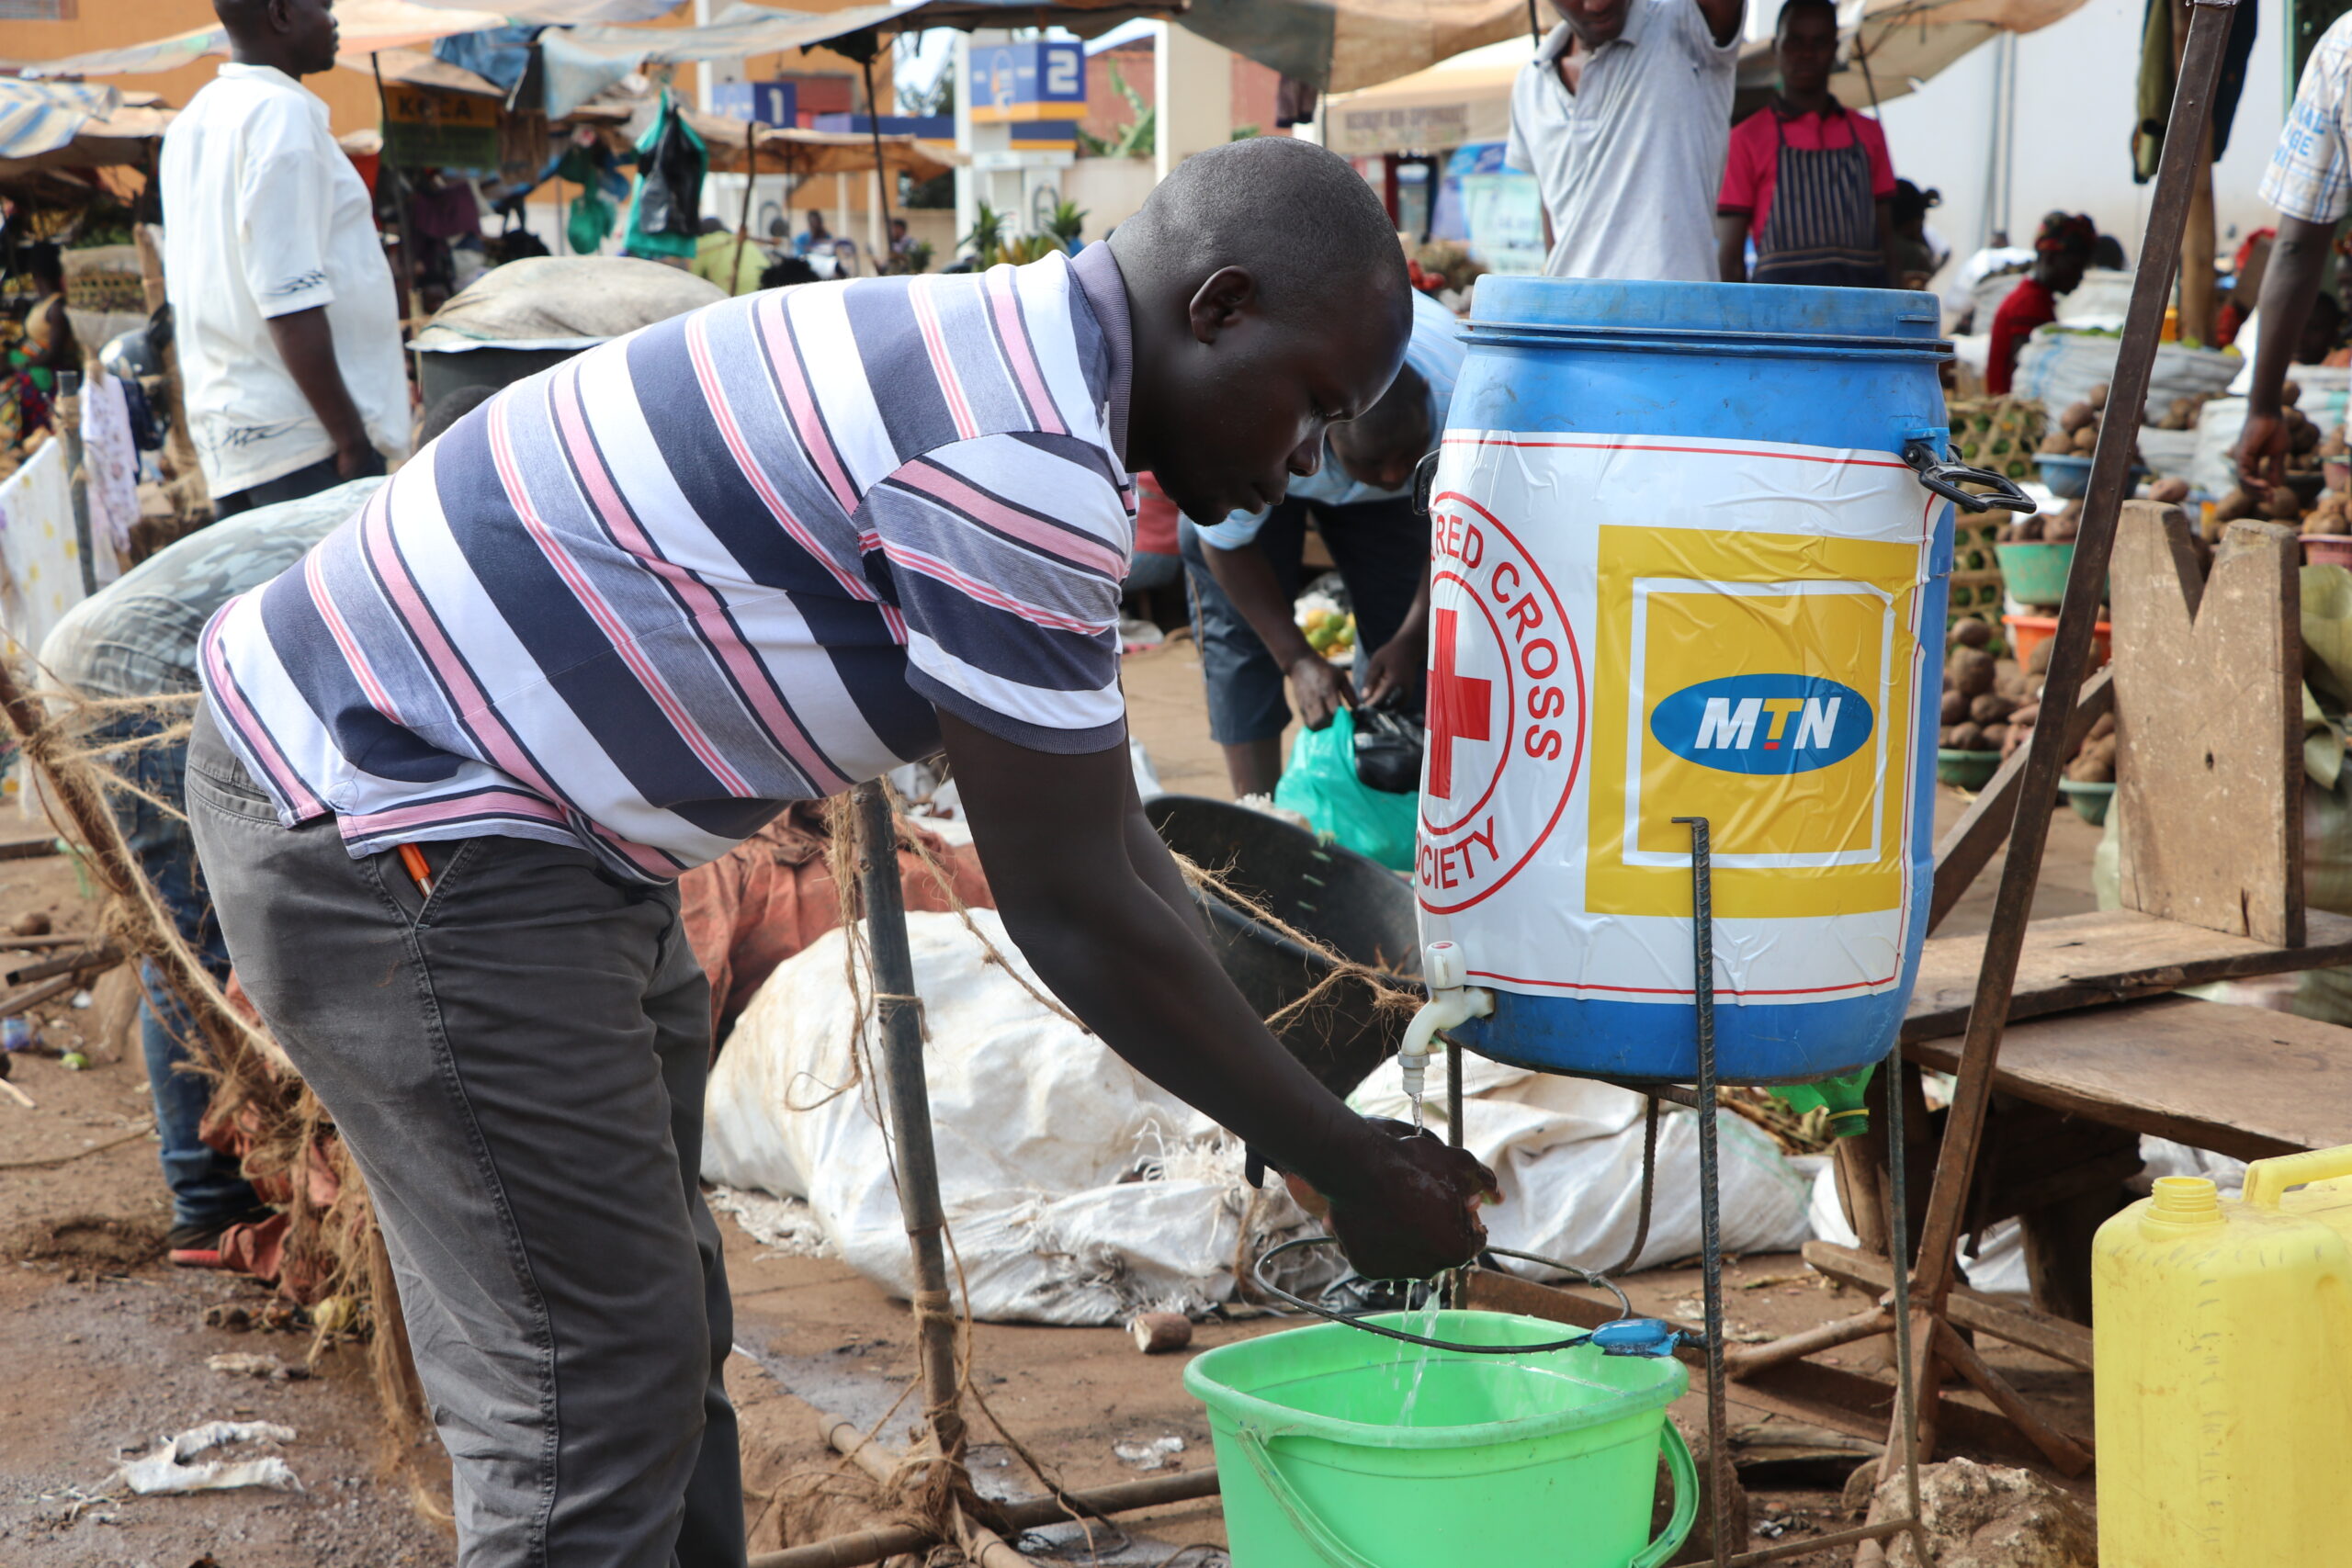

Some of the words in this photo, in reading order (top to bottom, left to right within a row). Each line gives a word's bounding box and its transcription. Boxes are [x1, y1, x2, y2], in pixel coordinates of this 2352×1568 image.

[1047, 49, 1079, 95] 2
[768, 87, 786, 127] 1
[1436, 513, 1484, 570] RED
[1491, 561, 1566, 761] CROSS
[1694, 696, 1841, 750] MTN
